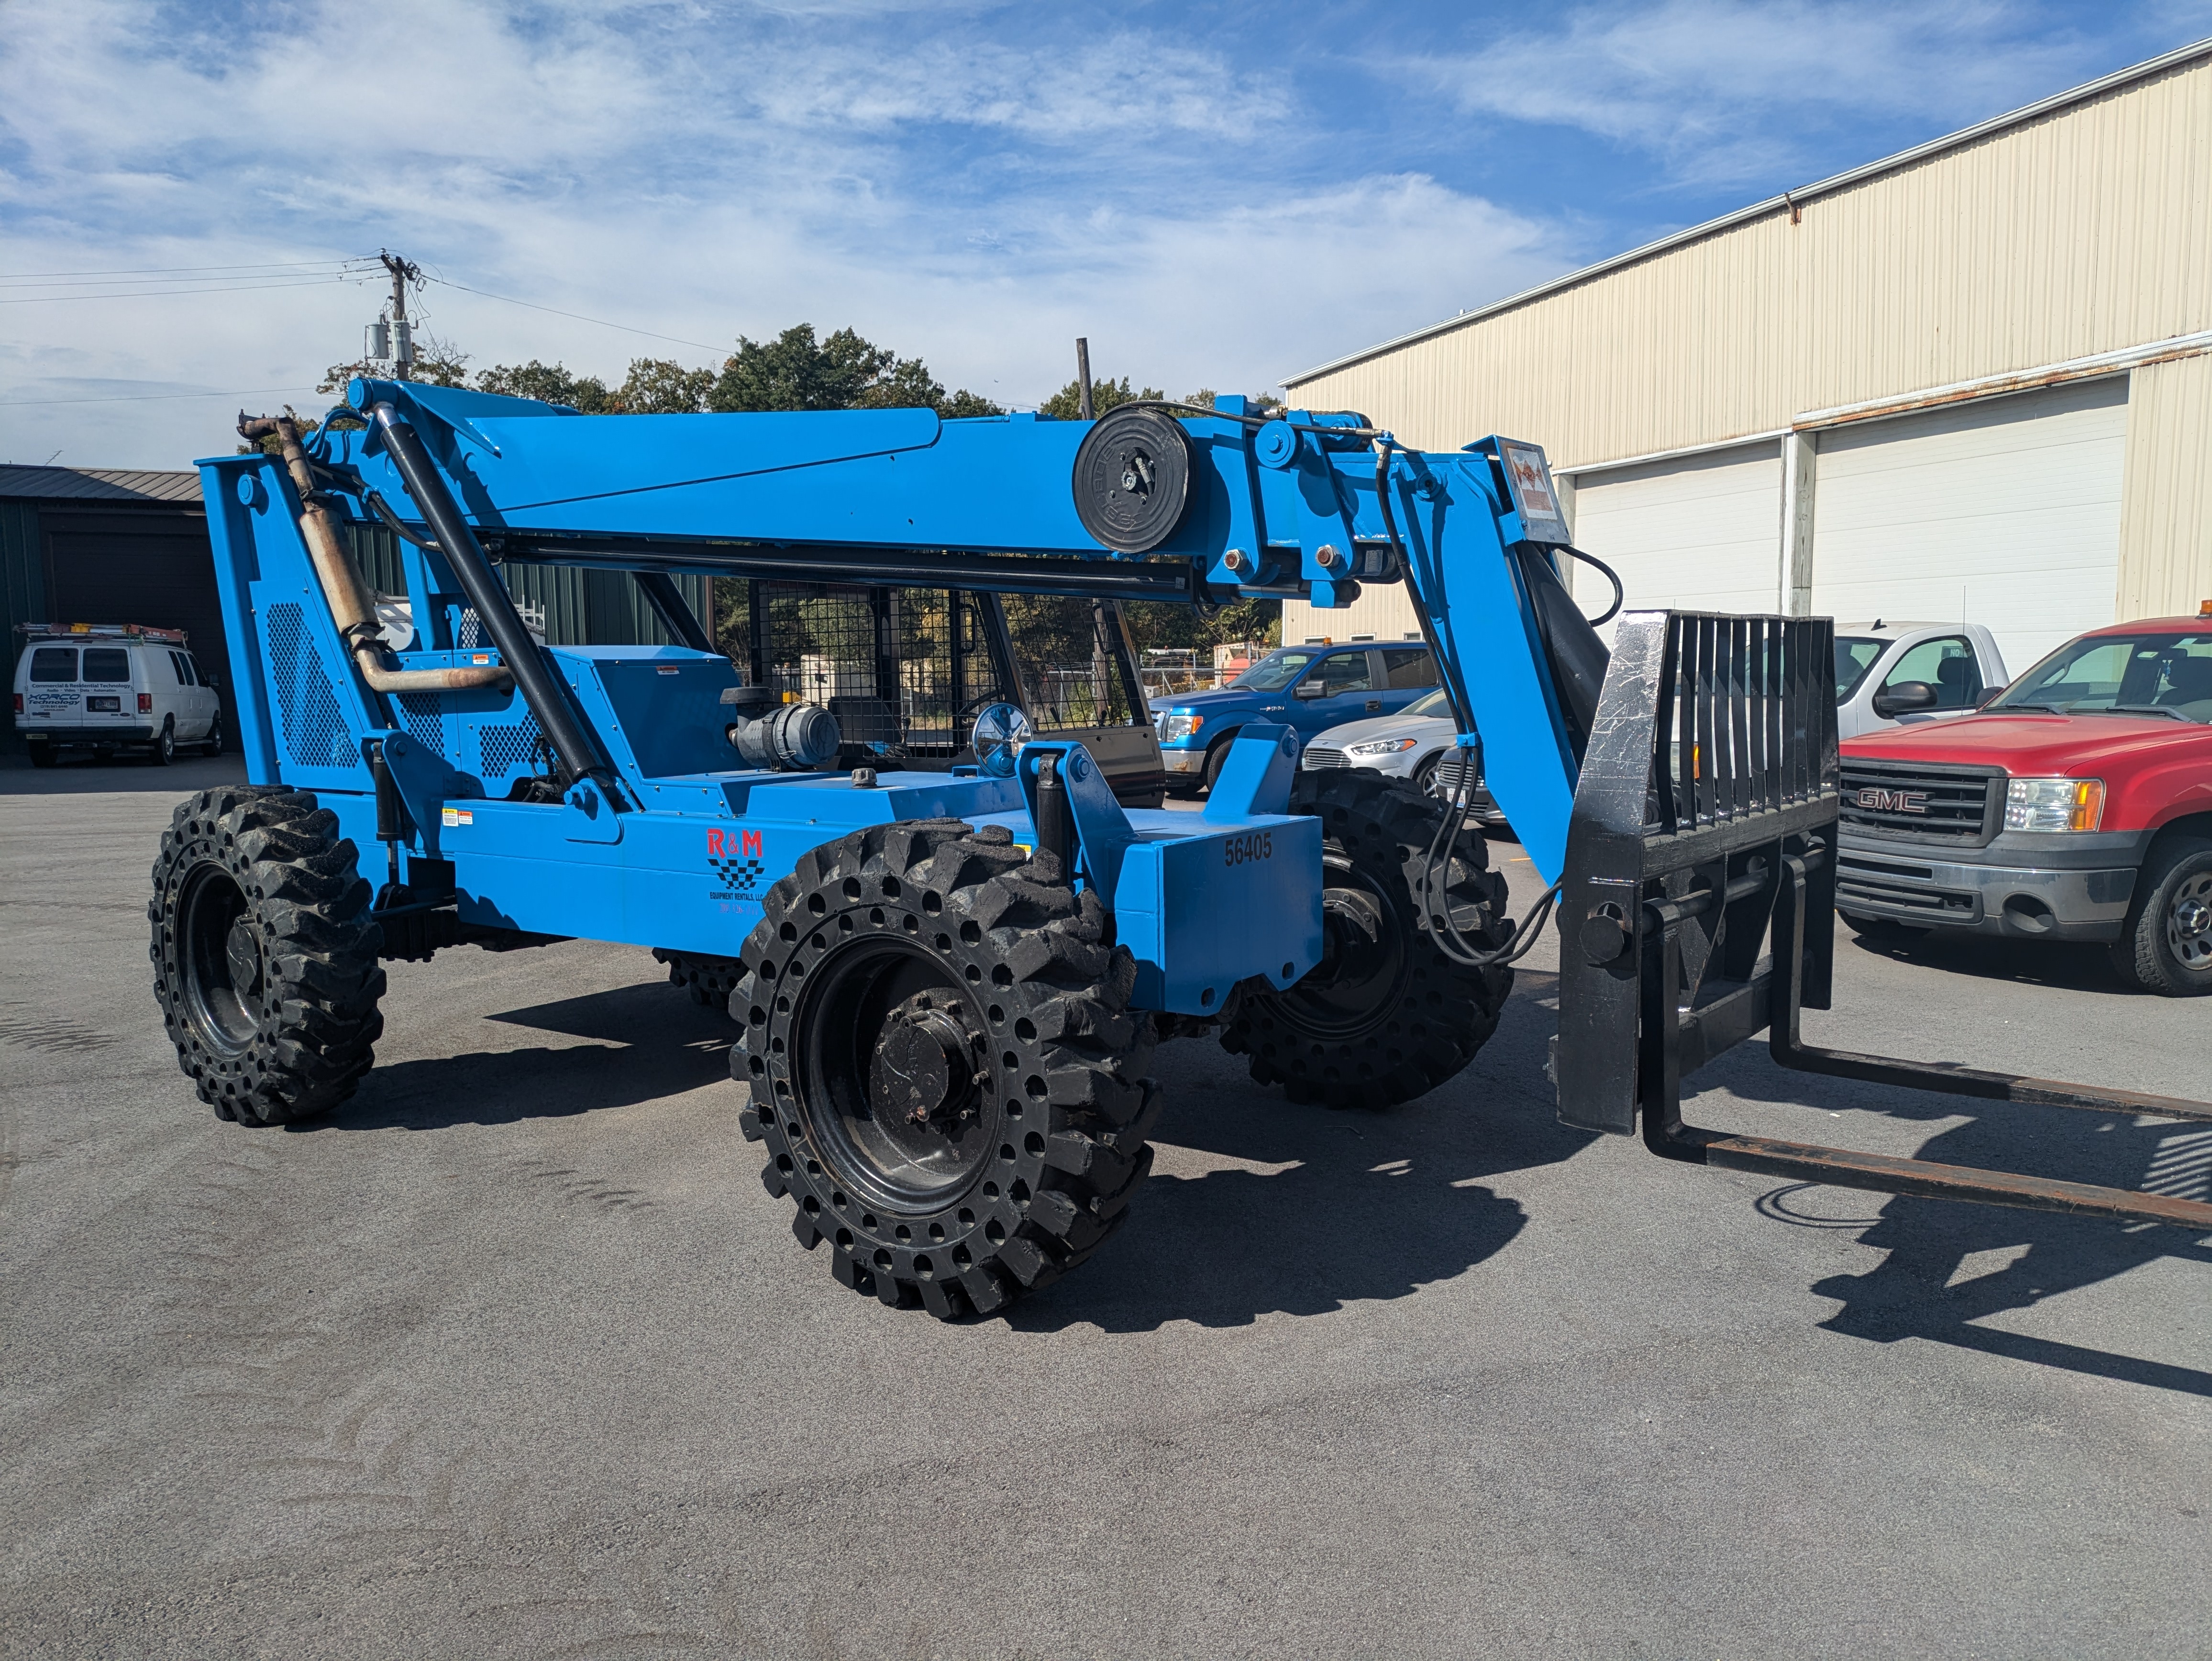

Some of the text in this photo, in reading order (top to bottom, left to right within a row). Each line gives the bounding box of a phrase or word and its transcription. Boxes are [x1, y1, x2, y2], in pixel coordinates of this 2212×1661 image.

[1950, 649, 1960, 657] NO
[1858, 789, 1928, 813] GMC
[1225, 832, 1272, 867] 56405
[709, 892, 733, 900] EQUIPMENT
[734, 893, 754, 902] RENTALS,
